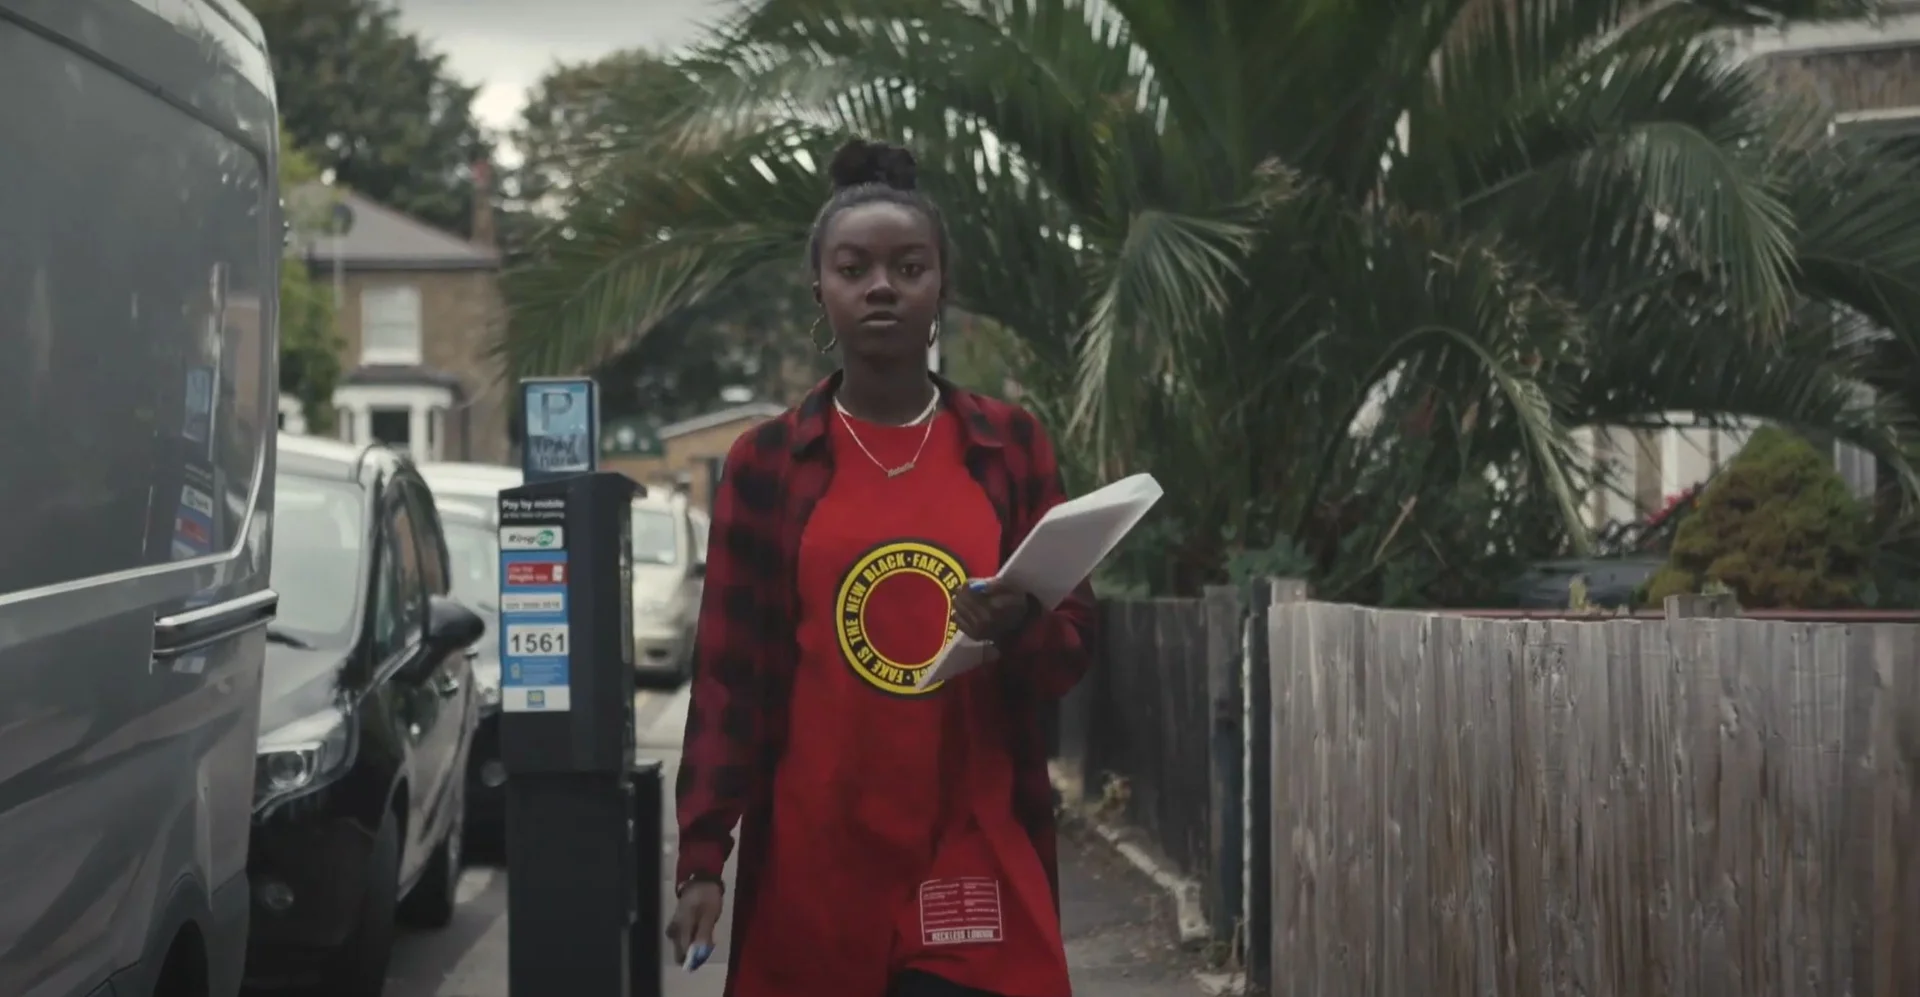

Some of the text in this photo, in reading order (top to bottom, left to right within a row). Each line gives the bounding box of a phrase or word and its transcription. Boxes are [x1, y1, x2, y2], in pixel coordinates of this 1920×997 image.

[541, 390, 575, 431] P
[502, 499, 565, 512] Pay by mobile
[912, 553, 959, 590] FAKE IS
[845, 552, 907, 684] FAKE IS THE NEW BLACK
[511, 632, 565, 653] 1561
[932, 929, 994, 942] RECKLESS LONDON
